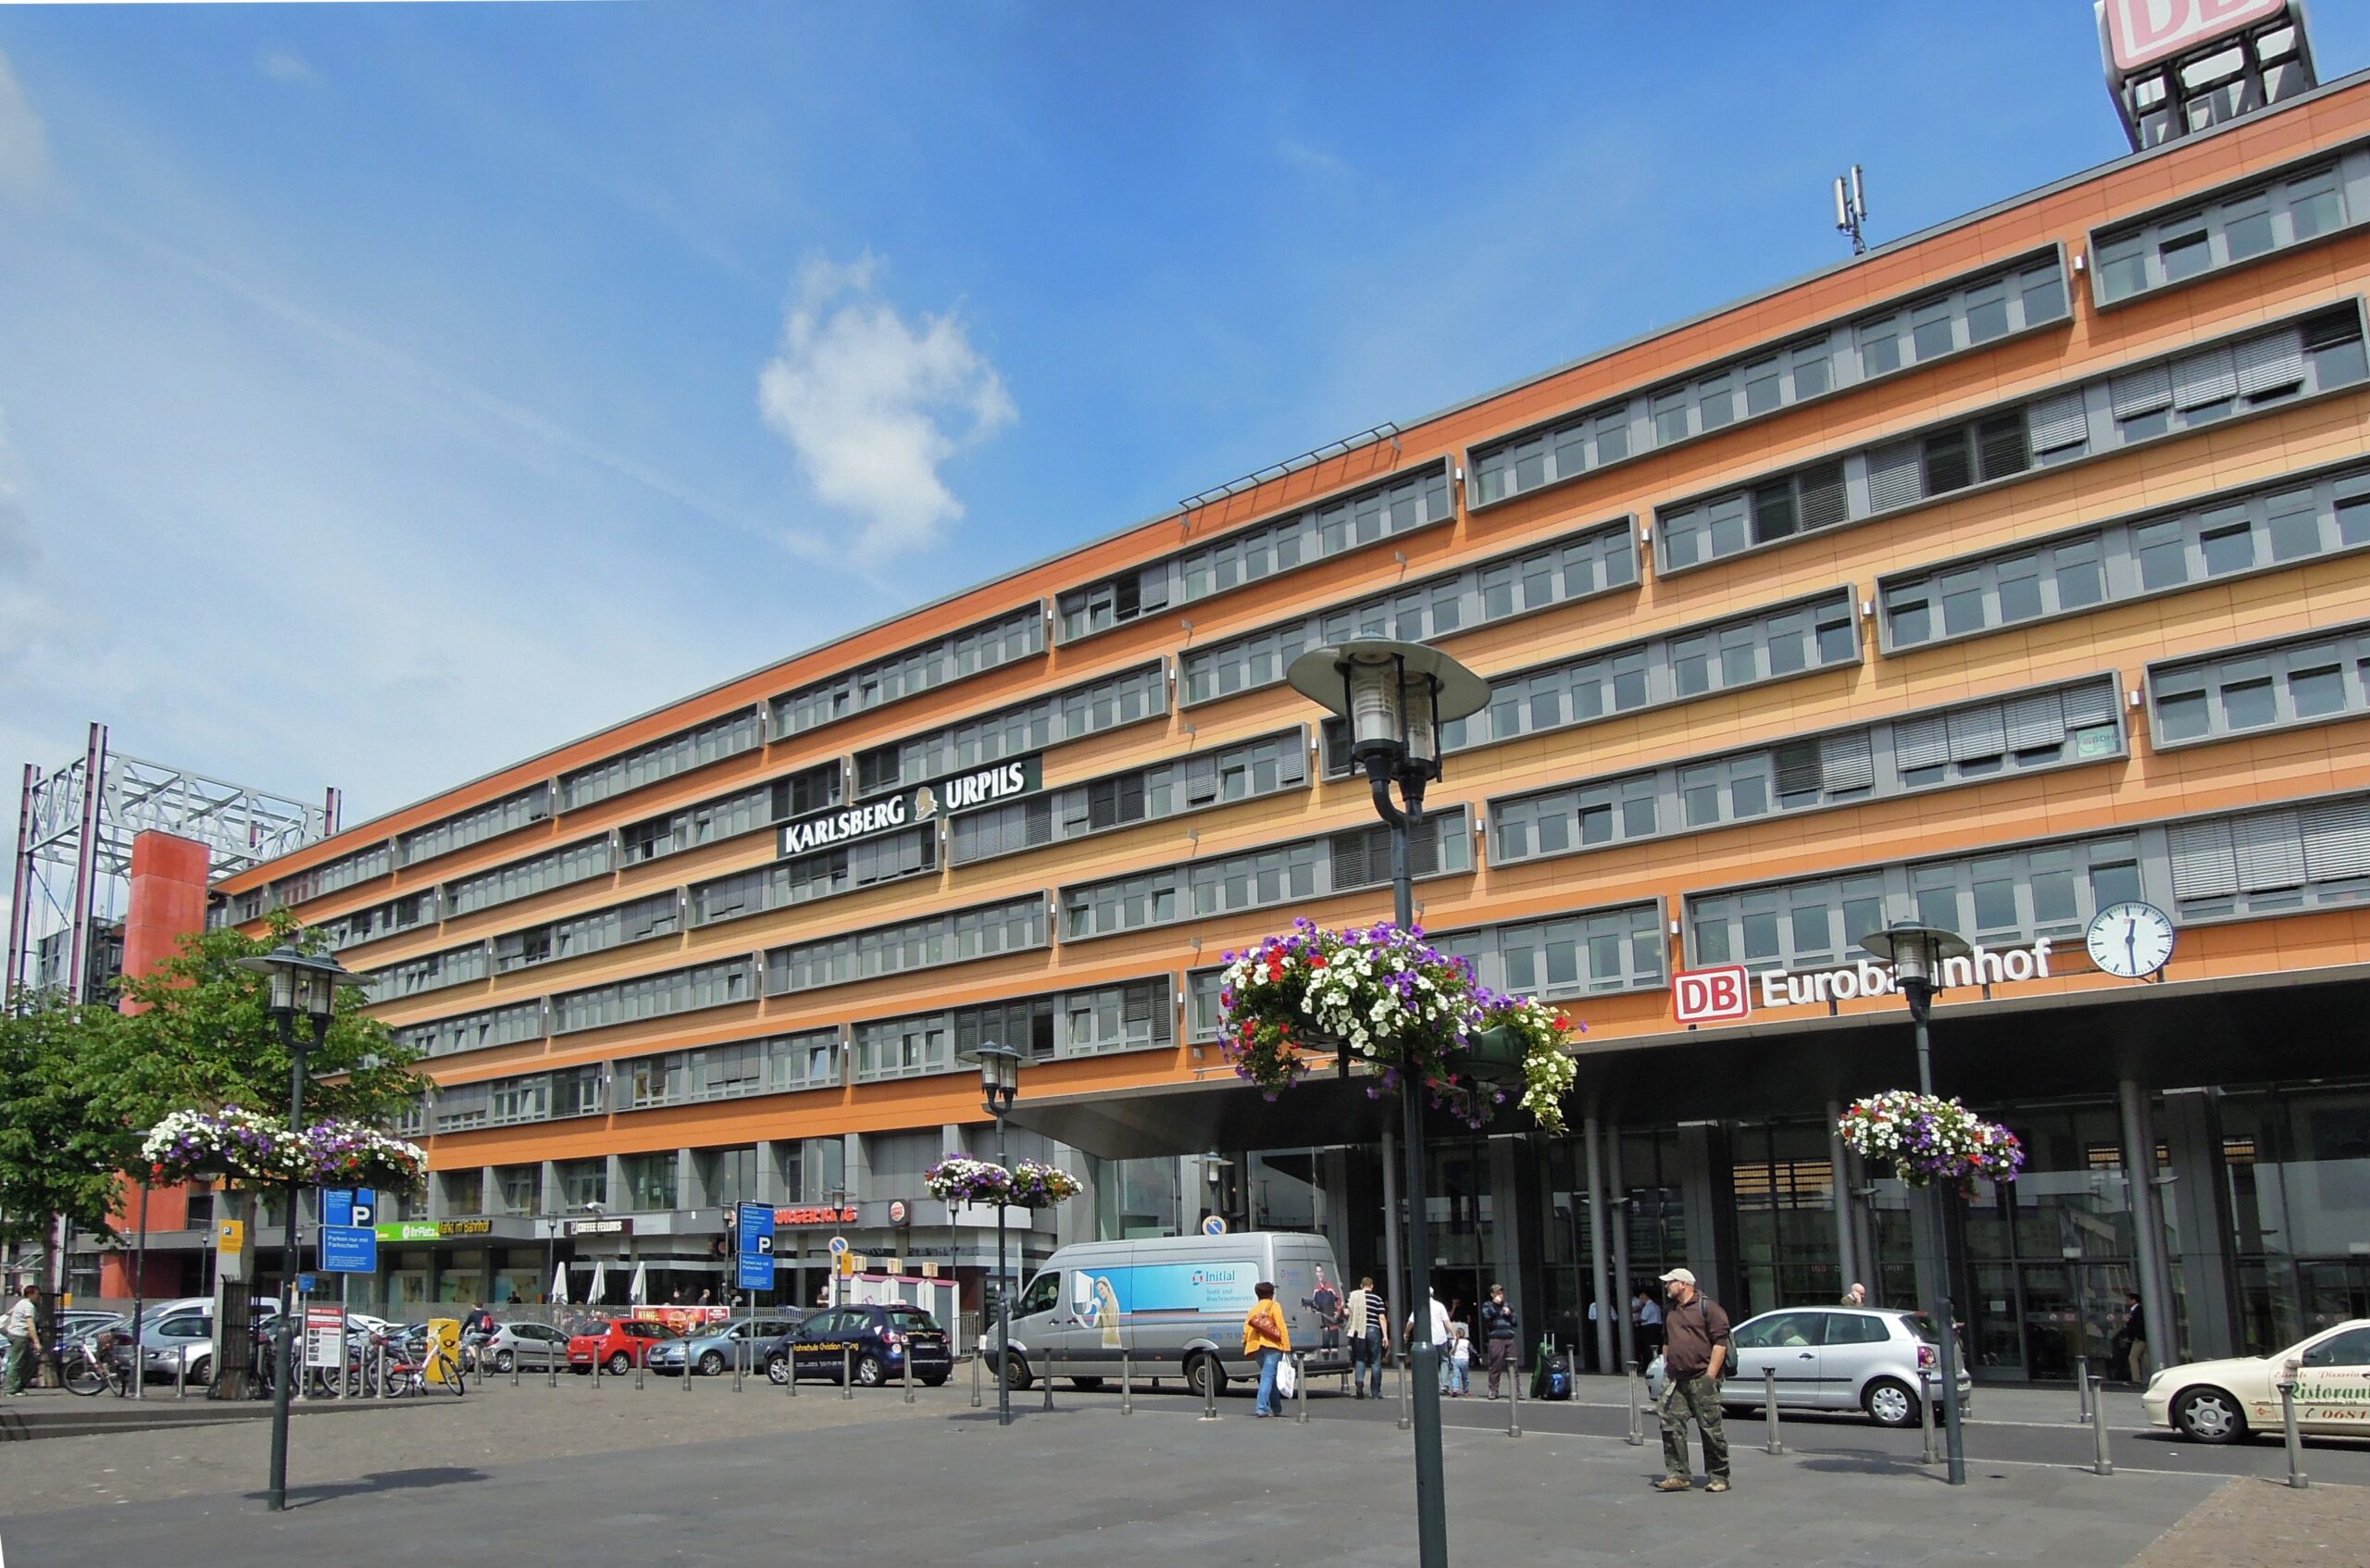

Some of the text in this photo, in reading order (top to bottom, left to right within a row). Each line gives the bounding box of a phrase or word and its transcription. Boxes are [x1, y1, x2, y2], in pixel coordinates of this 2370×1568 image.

[2128, 0, 2251, 50] D
[785, 762, 1025, 853] KARLSBERG URPILS
[1680, 974, 1739, 1014] DB
[353, 1206, 370, 1227] P
[774, 1207, 820, 1225] URGER
[578, 1222, 597, 1233] COFFEE
[758, 1237, 771, 1253] P
[889, 1260, 896, 1272] T
[928, 1263, 937, 1276] T
[1205, 1270, 1236, 1282] Initial
[819, 1342, 841, 1350] Christian
[2322, 1410, 2367, 1420] 0681
